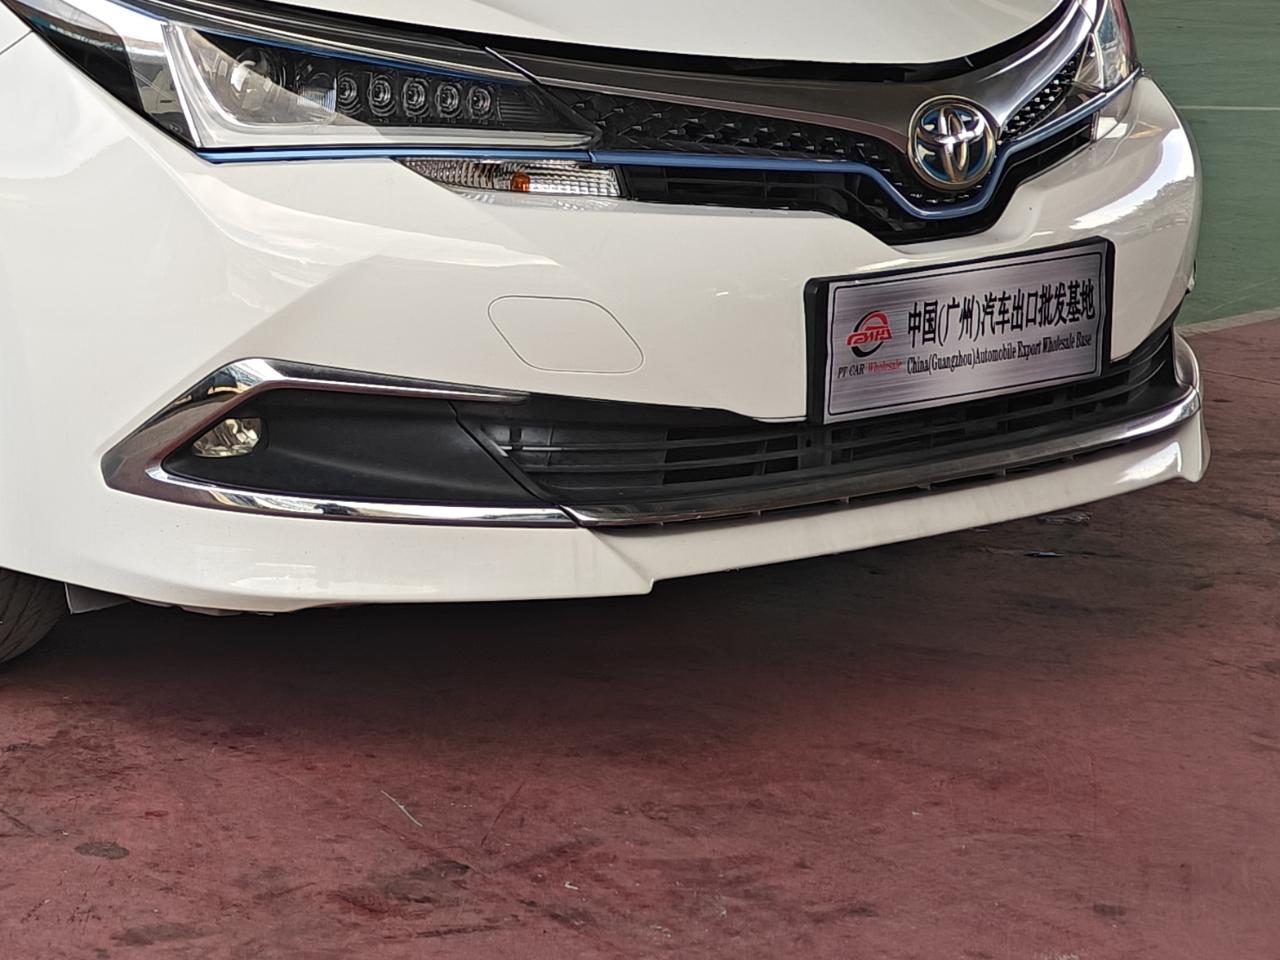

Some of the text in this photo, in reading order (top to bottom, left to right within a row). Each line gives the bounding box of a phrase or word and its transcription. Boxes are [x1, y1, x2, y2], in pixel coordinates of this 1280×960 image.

[907, 278, 1096, 349] 中国(广州)汽车出口批发基地
[1017, 341, 1042, 361] Export
[1075, 331, 1093, 349] Base
[837, 366, 847, 379] PT
[848, 362, 865, 377] CAR
